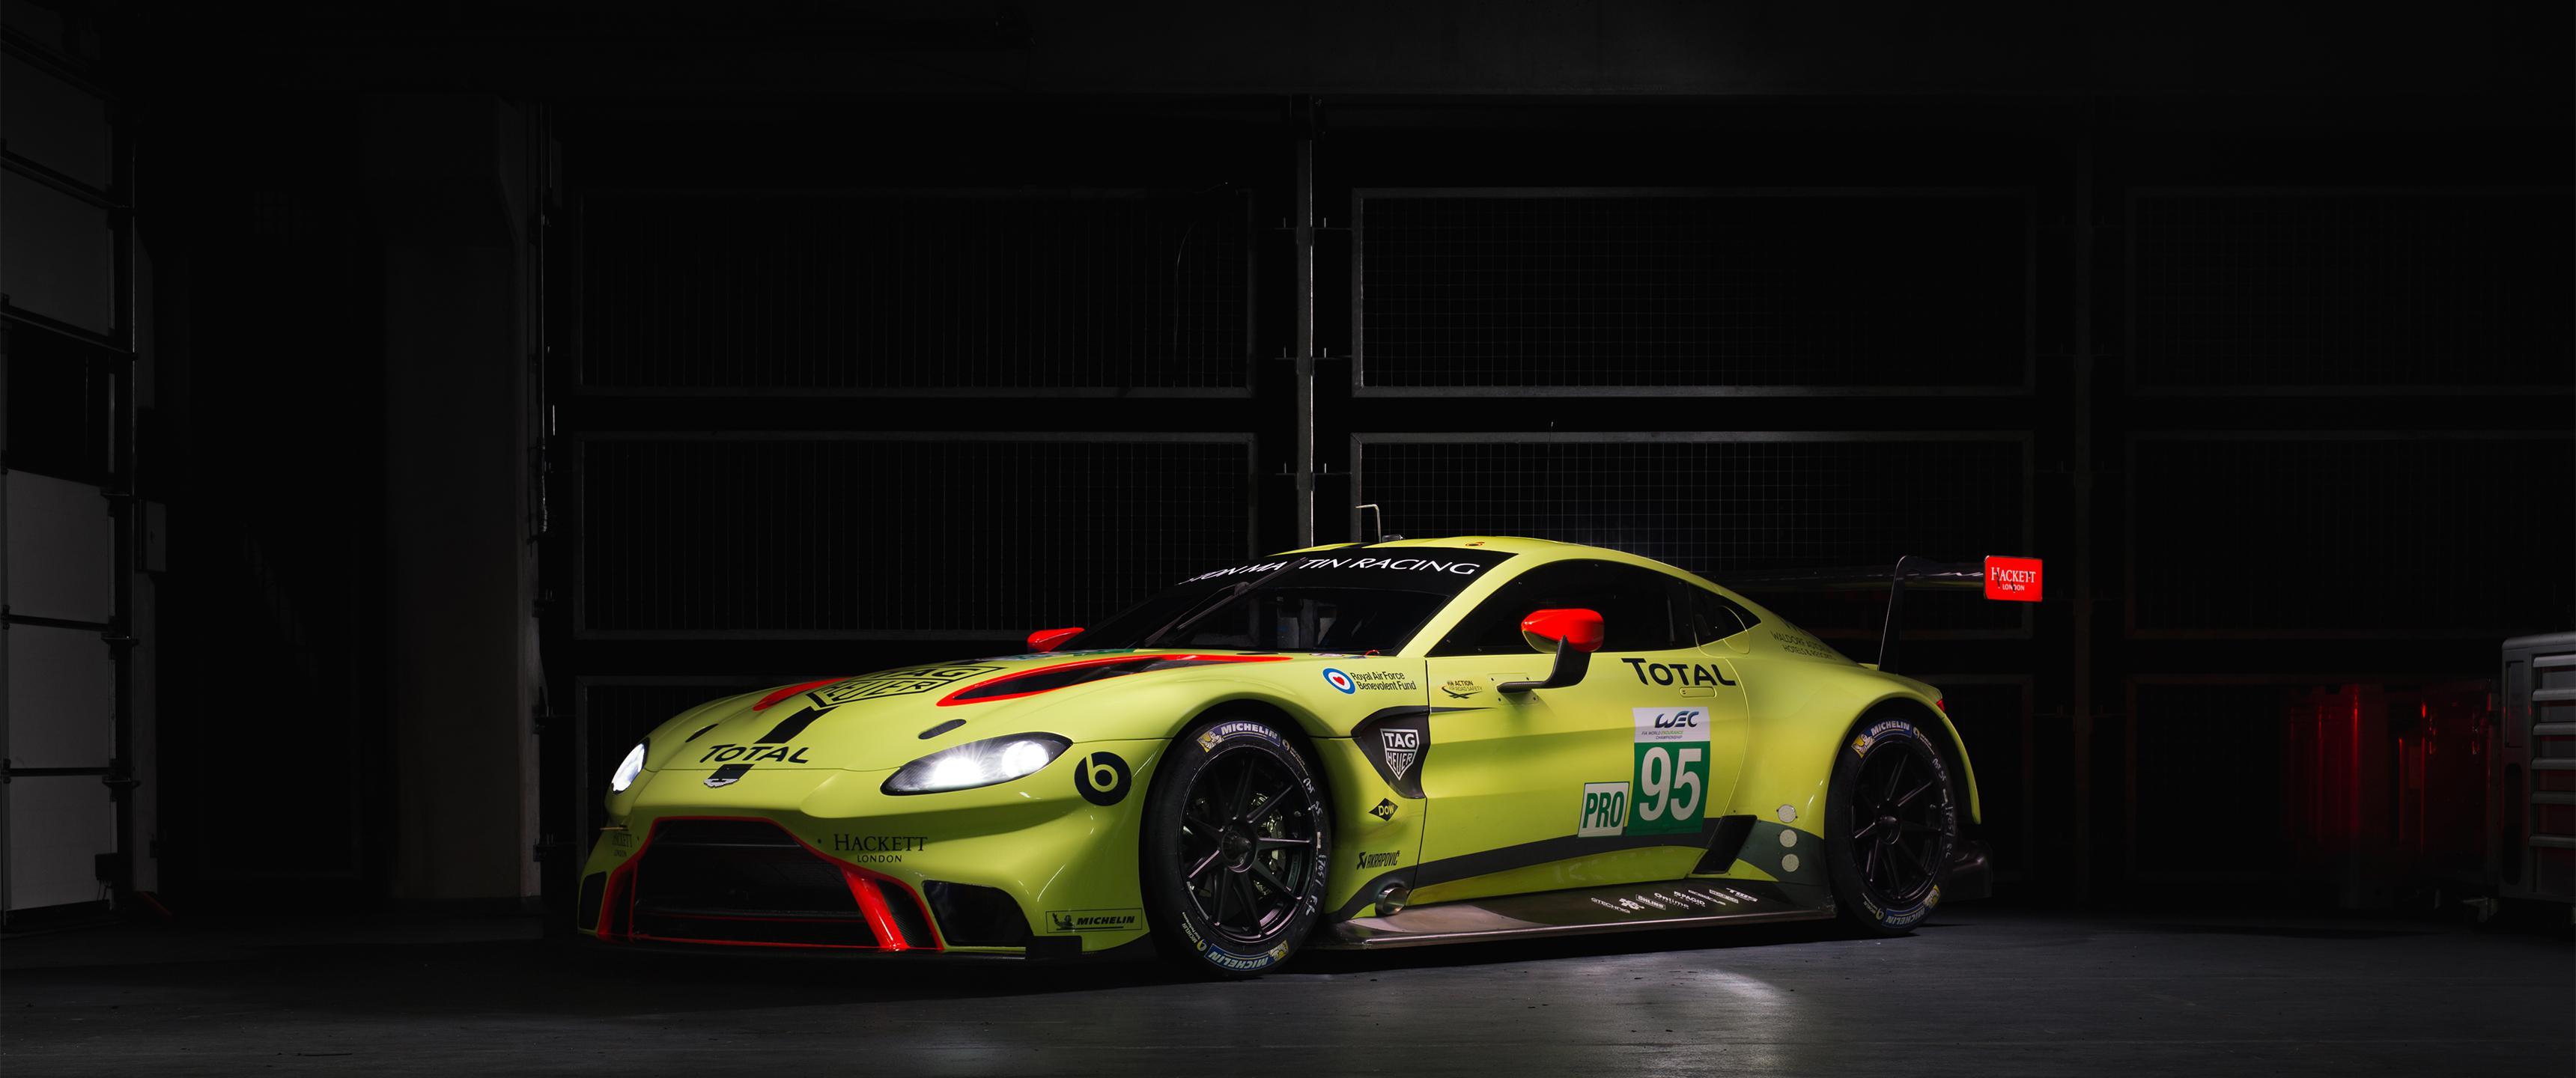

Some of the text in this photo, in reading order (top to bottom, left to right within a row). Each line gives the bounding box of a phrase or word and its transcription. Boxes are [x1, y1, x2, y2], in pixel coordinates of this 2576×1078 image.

[1239, 558, 1352, 574] MATIN
[1349, 558, 1480, 575] RACING
[1990, 567, 2036, 582] HACKETT
[1350, 671, 1406, 682] Royal Air Force
[1621, 658, 1737, 686] TOTAL
[1356, 680, 1417, 690] Benevolent Fund
[1655, 710, 1700, 728] WEC
[1221, 723, 1278, 739] MICHELIN
[1871, 721, 1910, 735] MICHELIN
[1385, 733, 1415, 748] TAG
[699, 743, 809, 764] TOTAL
[1387, 751, 1412, 775] HEUER
[1639, 747, 1701, 821] 95
[1582, 791, 1625, 829] PRO
[834, 833, 928, 851] HACKETT
[857, 855, 902, 863] LONDON
[1077, 916, 1135, 925] MICHELIN
[1886, 907, 1925, 925] MICHELIN
[1208, 951, 1269, 969] MICHELIN
